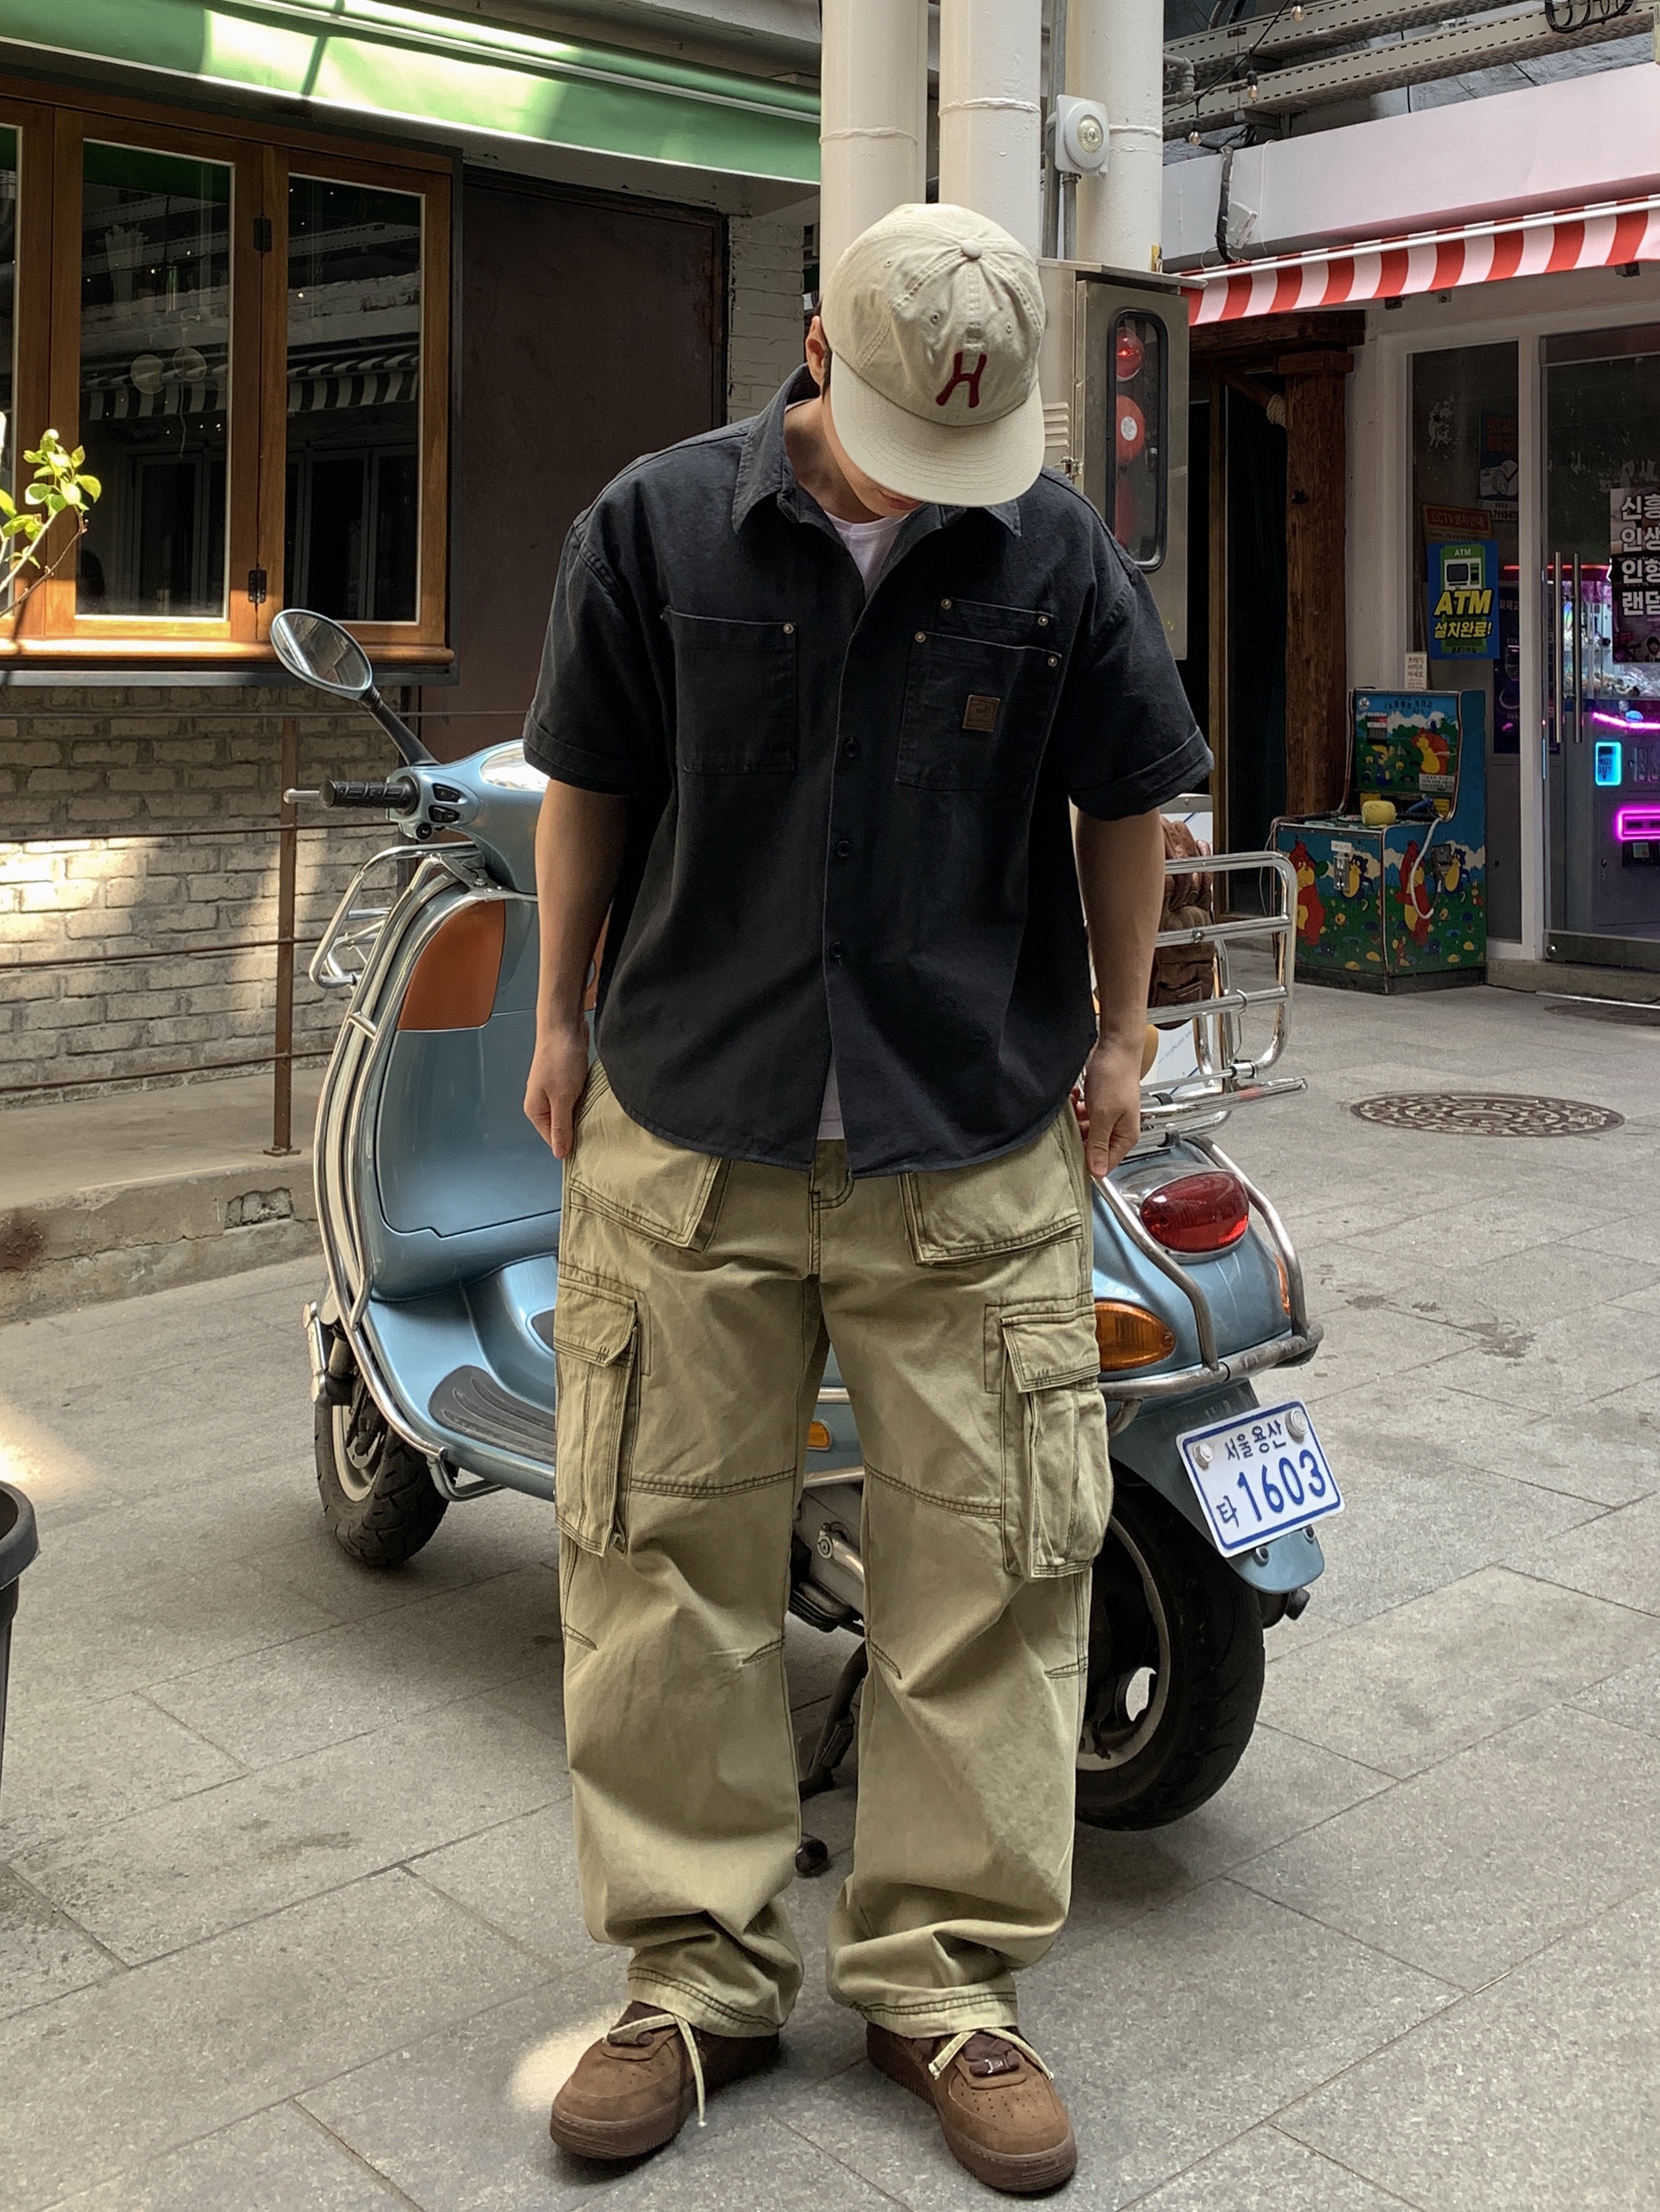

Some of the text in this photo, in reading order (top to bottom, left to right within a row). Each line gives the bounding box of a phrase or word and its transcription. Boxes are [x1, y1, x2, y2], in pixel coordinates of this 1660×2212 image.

[936, 352, 987, 409] H
[1621, 493, 1660, 520] 신흥
[1454, 548, 1471, 556] ATM
[1621, 559, 1660, 584] 인형
[1433, 589, 1492, 616] ATM
[1622, 591, 1660, 616] 랜덤
[1434, 621, 1492, 639] 설치완료!
[1216, 1449, 1326, 1528] 타 1603
